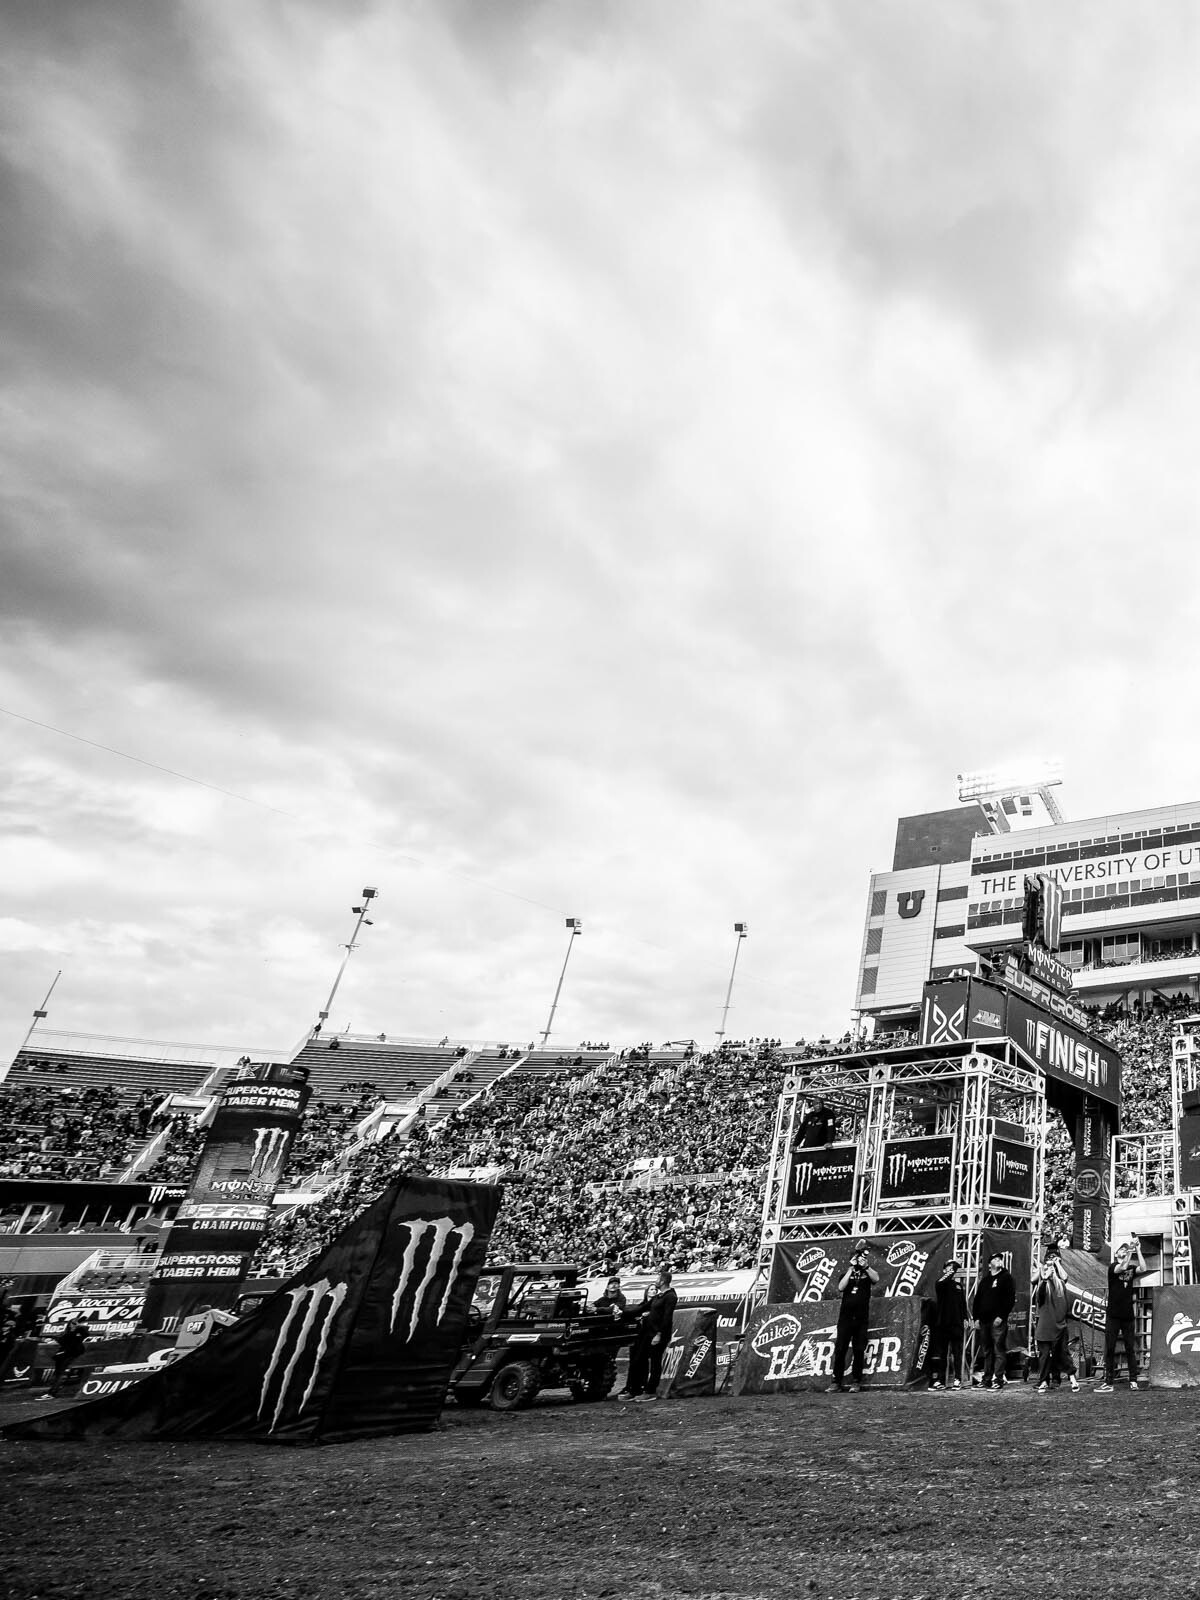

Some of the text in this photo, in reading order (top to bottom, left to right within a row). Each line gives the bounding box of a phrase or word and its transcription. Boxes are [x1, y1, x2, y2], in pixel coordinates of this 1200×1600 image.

[981, 875, 1017, 895] THE
[1144, 852, 1171, 870] OF
[1028, 943, 1073, 988] MONSTER
[1034, 967, 1067, 991] ENERGY
[1005, 966, 1089, 1029] SUPERCROSS
[1036, 1021, 1100, 1087] FINISH
[226, 1086, 301, 1098] SUPERCROSS
[227, 1096, 267, 1107] TABER
[269, 1098, 300, 1110] HEIM
[907, 1156, 951, 1168] MONSTER
[1006, 1160, 1028, 1172] MONSTER
[468, 1169, 476, 1178] 7
[812, 1164, 854, 1176] MONSTER
[158, 1255, 243, 1266] SUPERCROSS
[162, 1267, 204, 1278] TABER
[206, 1266, 240, 1277] HEIM
[75, 1298, 123, 1307] ROCKY
[187, 1321, 204, 1333] CAT
[758, 1322, 798, 1347] mike's
[685, 1339, 713, 1379] HARDER
[764, 1337, 902, 1381] HARER
